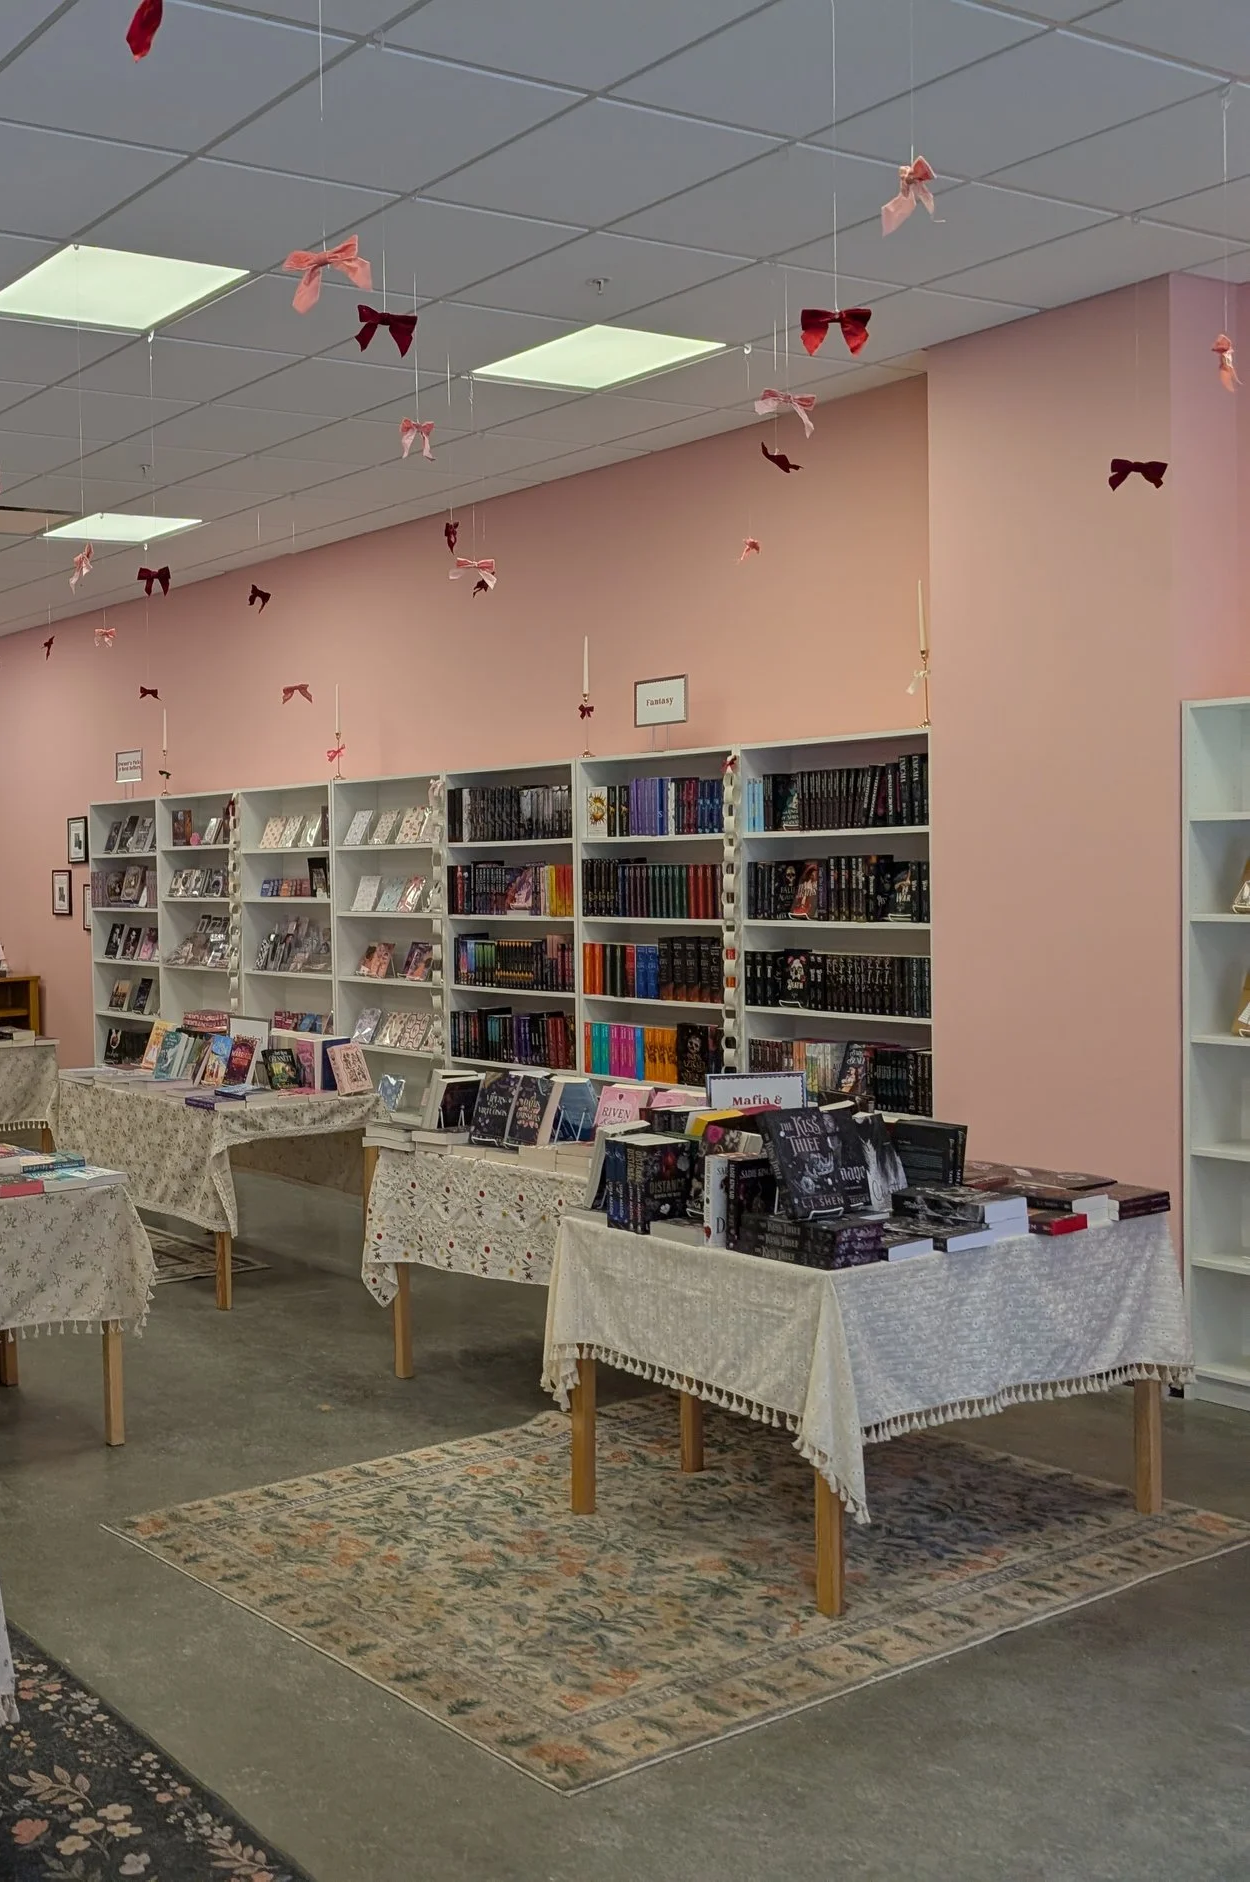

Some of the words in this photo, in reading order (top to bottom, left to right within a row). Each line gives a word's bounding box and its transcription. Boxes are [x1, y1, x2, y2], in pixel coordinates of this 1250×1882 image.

[646, 697, 674, 707] Fantasy
[732, 1095, 769, 1106] Mafia
[774, 1095, 782, 1104] &
[602, 1107, 631, 1119] RIVEN
[780, 1122, 794, 1131] THE
[791, 1115, 822, 1137] KISS
[786, 1136, 820, 1156] THIEF
[840, 1166, 868, 1184] nage
[820, 1196, 844, 1205] SHEN
